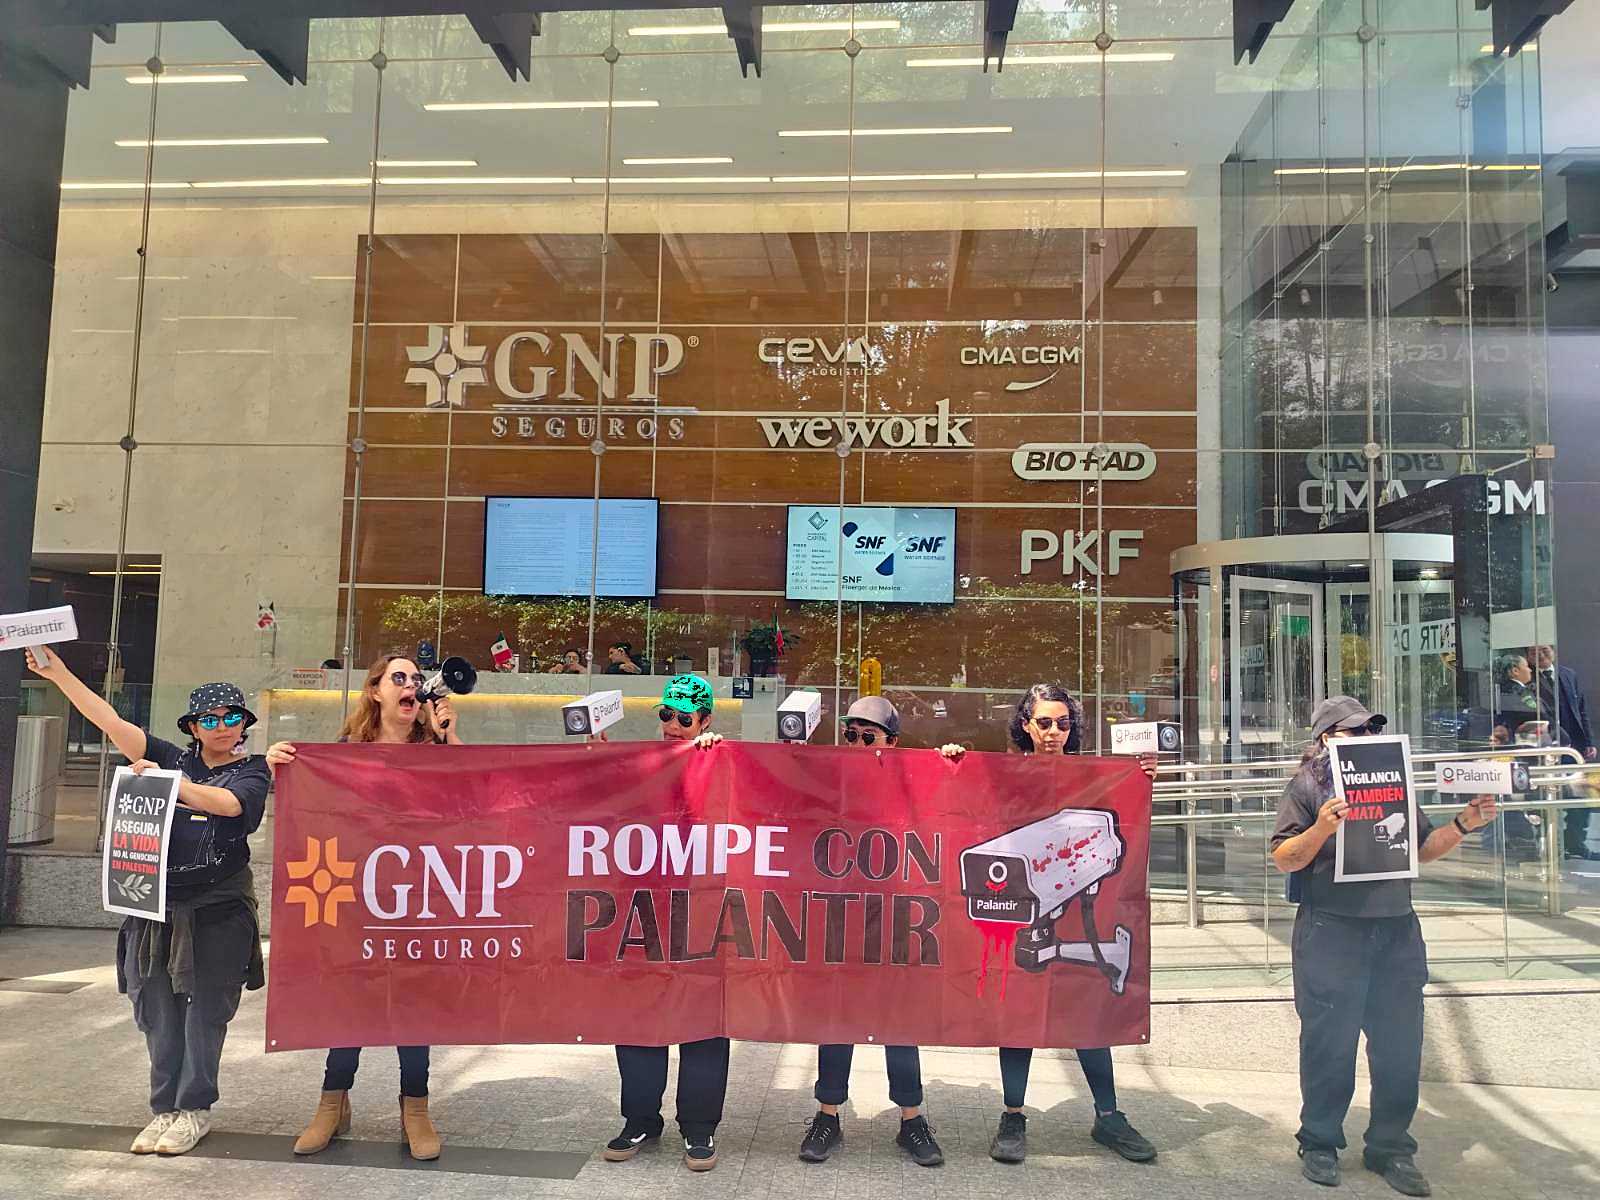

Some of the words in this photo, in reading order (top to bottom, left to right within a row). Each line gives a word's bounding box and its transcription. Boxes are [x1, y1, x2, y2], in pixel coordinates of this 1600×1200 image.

[960, 346, 1017, 365] CMA
[1021, 346, 1080, 364] CGM
[812, 367, 880, 376] LOGISTICS
[491, 416, 685, 439] SEGUROS
[757, 398, 974, 447] wework
[855, 536, 886, 549] SNF
[905, 536, 946, 553] SNF
[1020, 529, 1144, 575] PKF
[842, 576, 862, 584] SNF
[1340, 760, 1356, 772] LA
[1342, 771, 1401, 785] VIGILANCIA
[1456, 768, 1503, 782] Palantir
[1346, 785, 1404, 803] TAMBIÉN
[132, 795, 166, 816] GNP
[1347, 806, 1384, 820] MATA
[114, 819, 160, 836] ASEGURA
[113, 832, 129, 849] LA
[131, 834, 160, 852] VIDA
[122, 851, 128, 859] AL
[568, 824, 790, 877] ROMPE
[813, 828, 942, 884] CON
[976, 900, 1018, 911] Palantir
[566, 887, 942, 967] PALANTIR
[362, 937, 522, 960] SEGUROS
